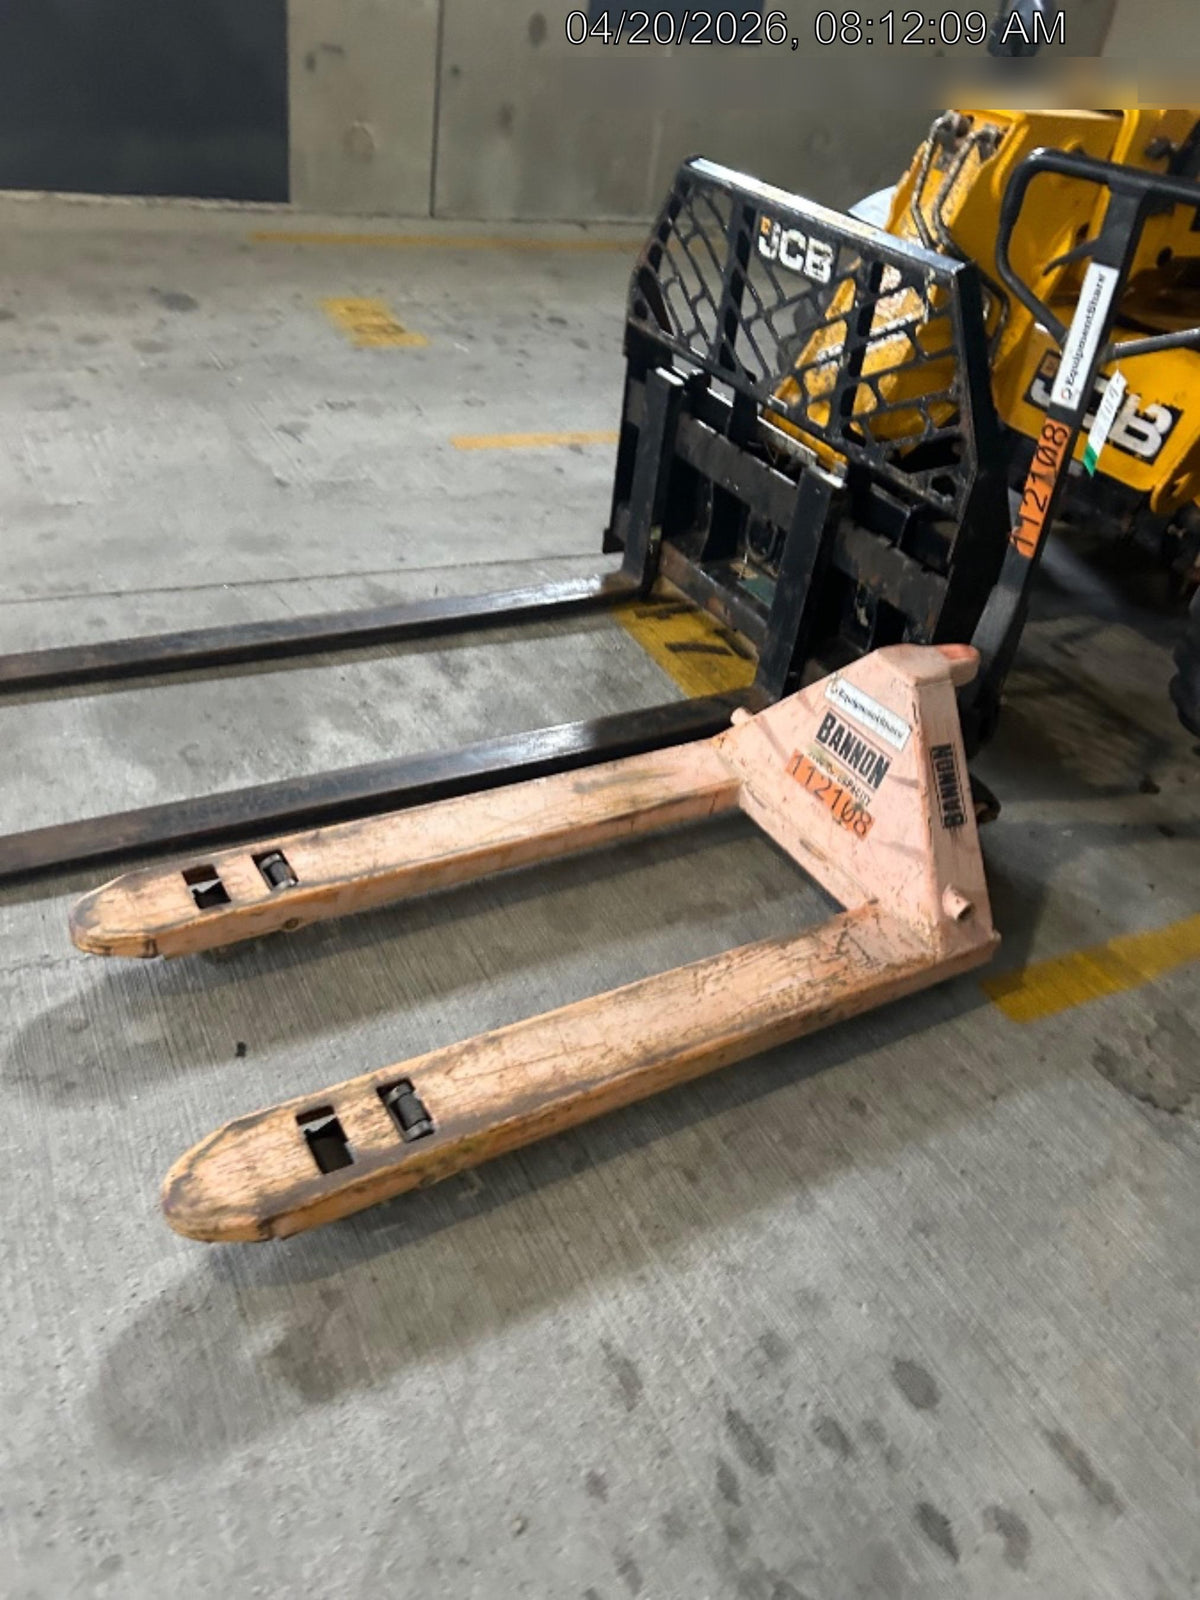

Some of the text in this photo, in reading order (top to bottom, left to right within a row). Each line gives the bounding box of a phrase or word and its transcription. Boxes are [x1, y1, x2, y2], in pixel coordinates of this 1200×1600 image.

[758, 215, 834, 284] JCB
[1064, 273, 1105, 387] EquipmentShare
[1009, 424, 1068, 548] 112108
[816, 711, 890, 789] BANNON
[932, 744, 966, 828] BANNON
[793, 753, 872, 836] 112108
